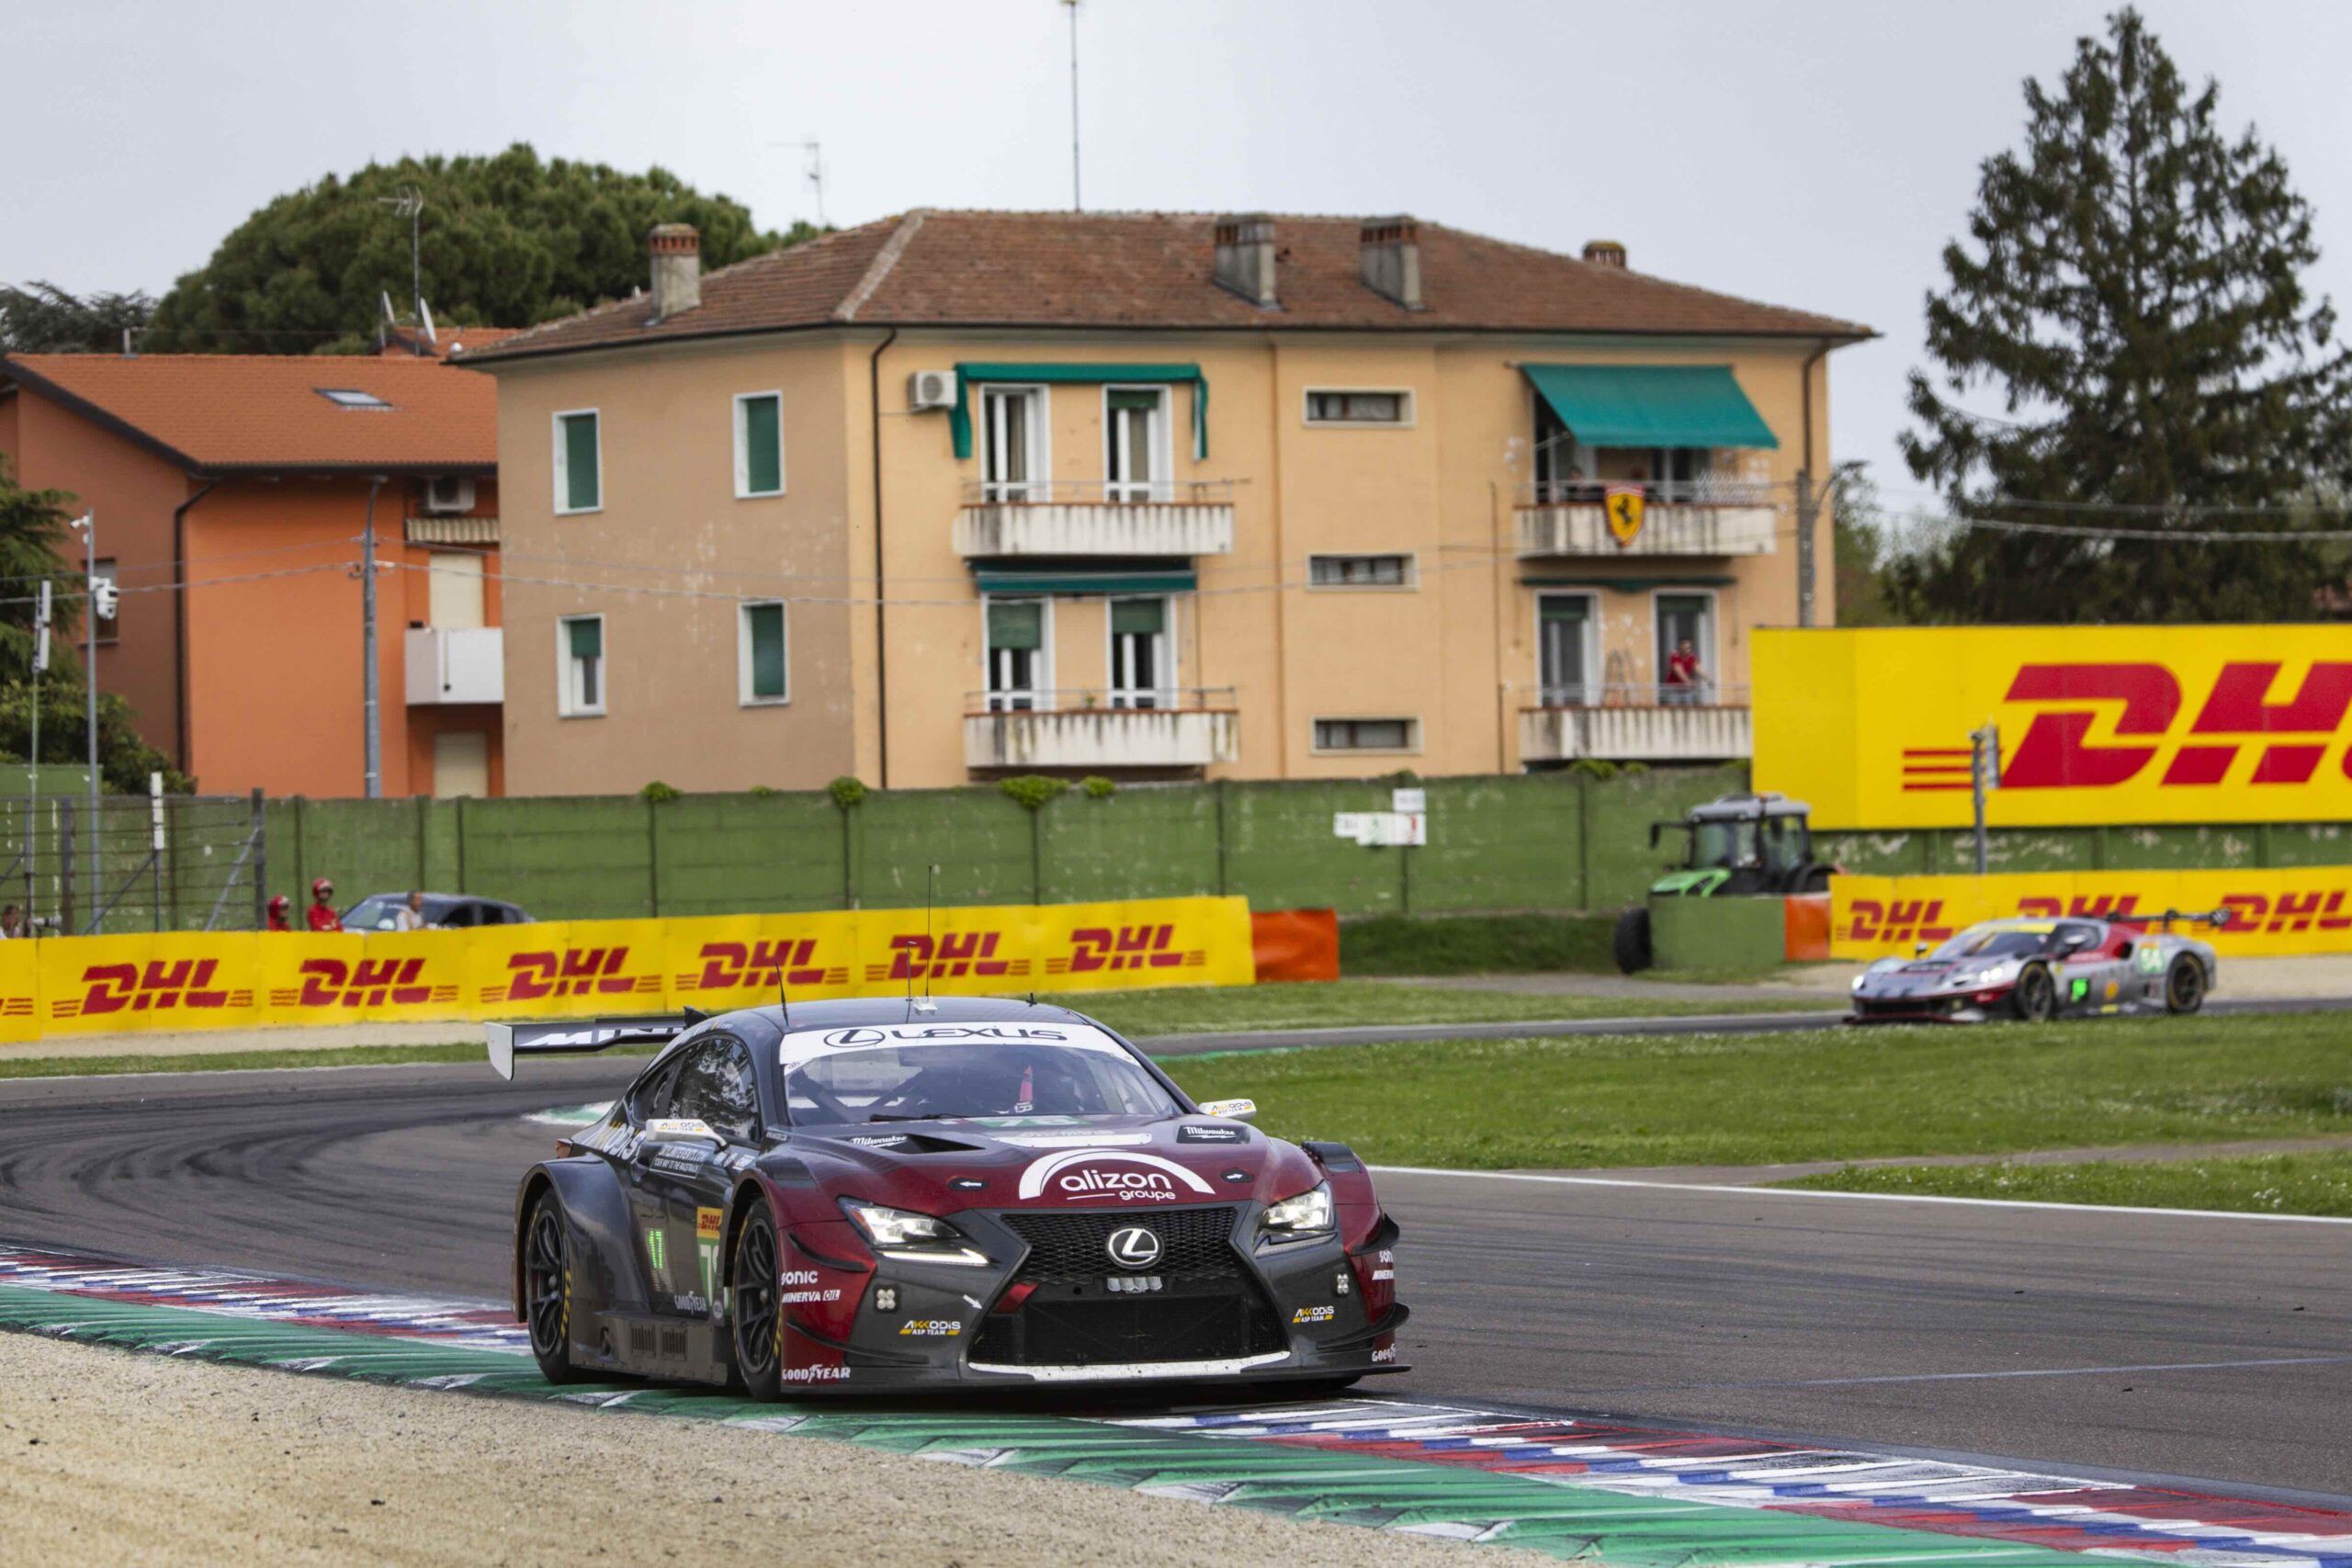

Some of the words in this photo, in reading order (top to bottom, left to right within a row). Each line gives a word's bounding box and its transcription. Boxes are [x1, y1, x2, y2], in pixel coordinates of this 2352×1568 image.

[1998, 661, 2352, 789] DH
[1850, 900, 1953, 942] DHL
[2219, 891, 2352, 932] DHL
[698, 939, 826, 989] DHL
[888, 932, 1009, 979] DHL
[1069, 924, 1183, 972] DHL
[81, 958, 230, 1015] DHL
[300, 957, 432, 1007] DHL
[507, 946, 636, 1000] DHL
[891, 1028, 1068, 1041] LEXUS
[851, 1135, 908, 1145] Milwaukee
[1183, 1126, 1237, 1136] Milwaukee
[1059, 1169, 1172, 1191] alizon
[1119, 1189, 1176, 1201] groupe
[824, 1290, 840, 1301] OIL
